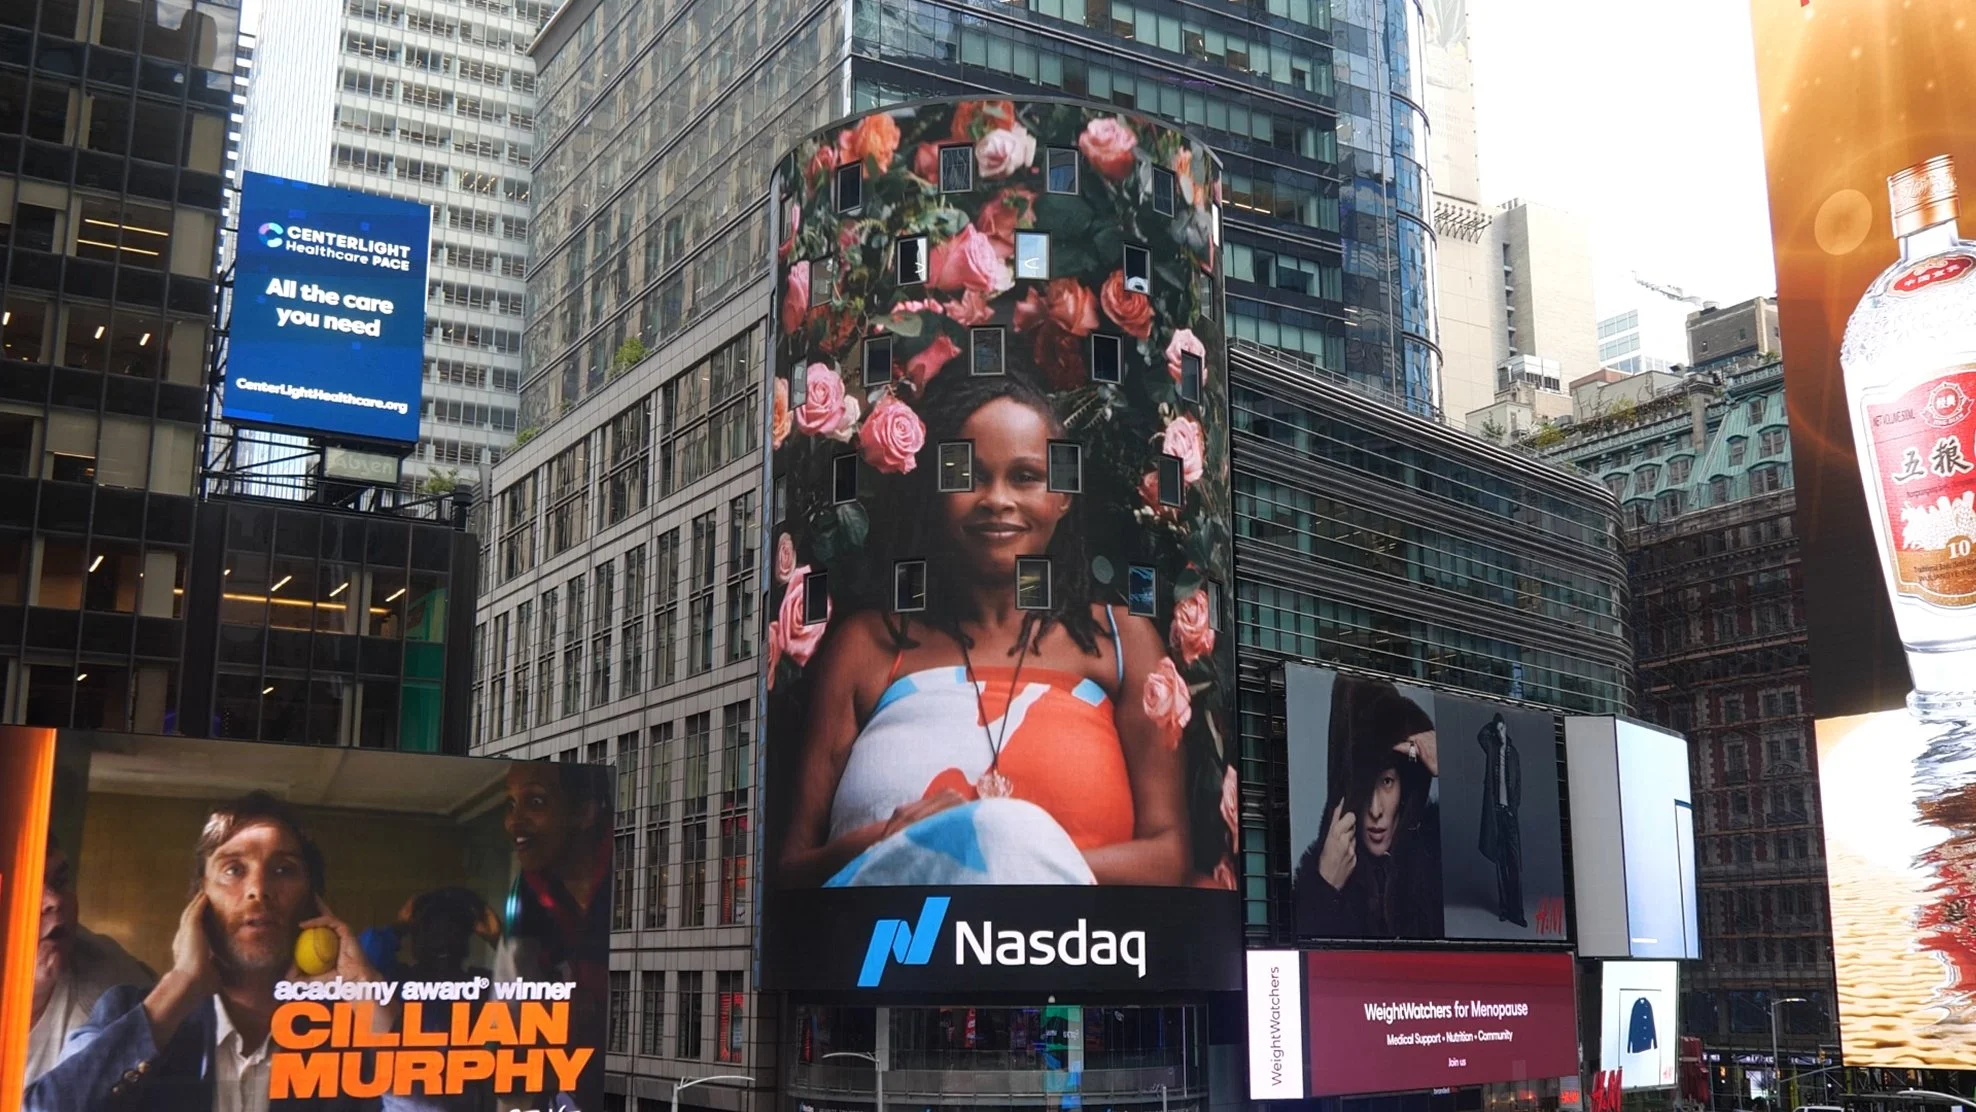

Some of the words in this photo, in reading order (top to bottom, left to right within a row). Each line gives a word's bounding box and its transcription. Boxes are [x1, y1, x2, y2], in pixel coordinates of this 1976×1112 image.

[286, 240, 369, 264] Healthcare
[372, 255, 410, 271] PACE
[287, 226, 411, 258] CENTERLIGHT
[265, 277, 297, 299] All
[300, 284, 340, 305] the
[343, 294, 394, 315] care
[276, 307, 320, 327] you
[323, 315, 381, 337] need
[236, 378, 408, 414] CenterLightHealthcare.org
[1948, 539, 1971, 559] 10
[956, 919, 1146, 978] Nasdaq
[274, 977, 396, 1006] academy
[494, 977, 577, 1000] winner
[270, 1002, 569, 1048] CILLIAN
[1269, 966, 1285, 1087] WeightWatchers
[1364, 1002, 1452, 1024] WeightWatchers
[1454, 1001, 1469, 1018] for
[1471, 1000, 1528, 1019] Menopause
[1387, 1033, 1414, 1046] Medical
[1415, 1033, 1442, 1046] Support
[1446, 1031, 1473, 1043] Nutrition
[1477, 1029, 1513, 1042] Community
[269, 1048, 595, 1099] MURPHY
[1448, 1057, 1458, 1067] Join
[1459, 1058, 1466, 1067] us
